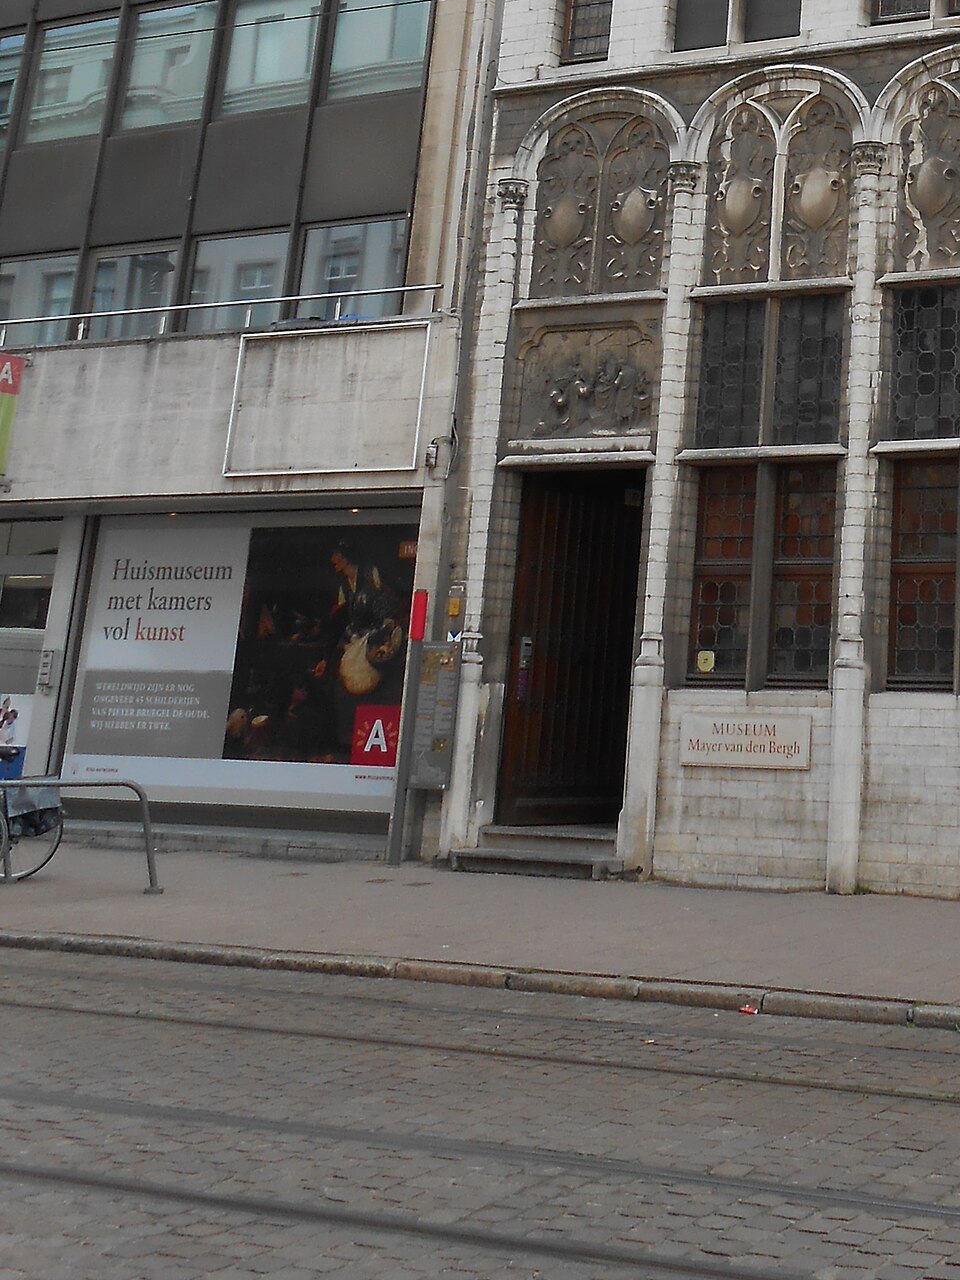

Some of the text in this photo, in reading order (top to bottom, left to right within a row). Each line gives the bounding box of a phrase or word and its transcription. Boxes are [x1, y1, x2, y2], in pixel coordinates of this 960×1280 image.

[112, 558, 233, 581] Huismuseum
[106, 586, 213, 611] met kamers
[103, 617, 186, 641] vol kunst
[363, 719, 388, 753] A
[711, 722, 776, 737] MUSEUM
[688, 738, 801, 759] Mayer van den Bergh
